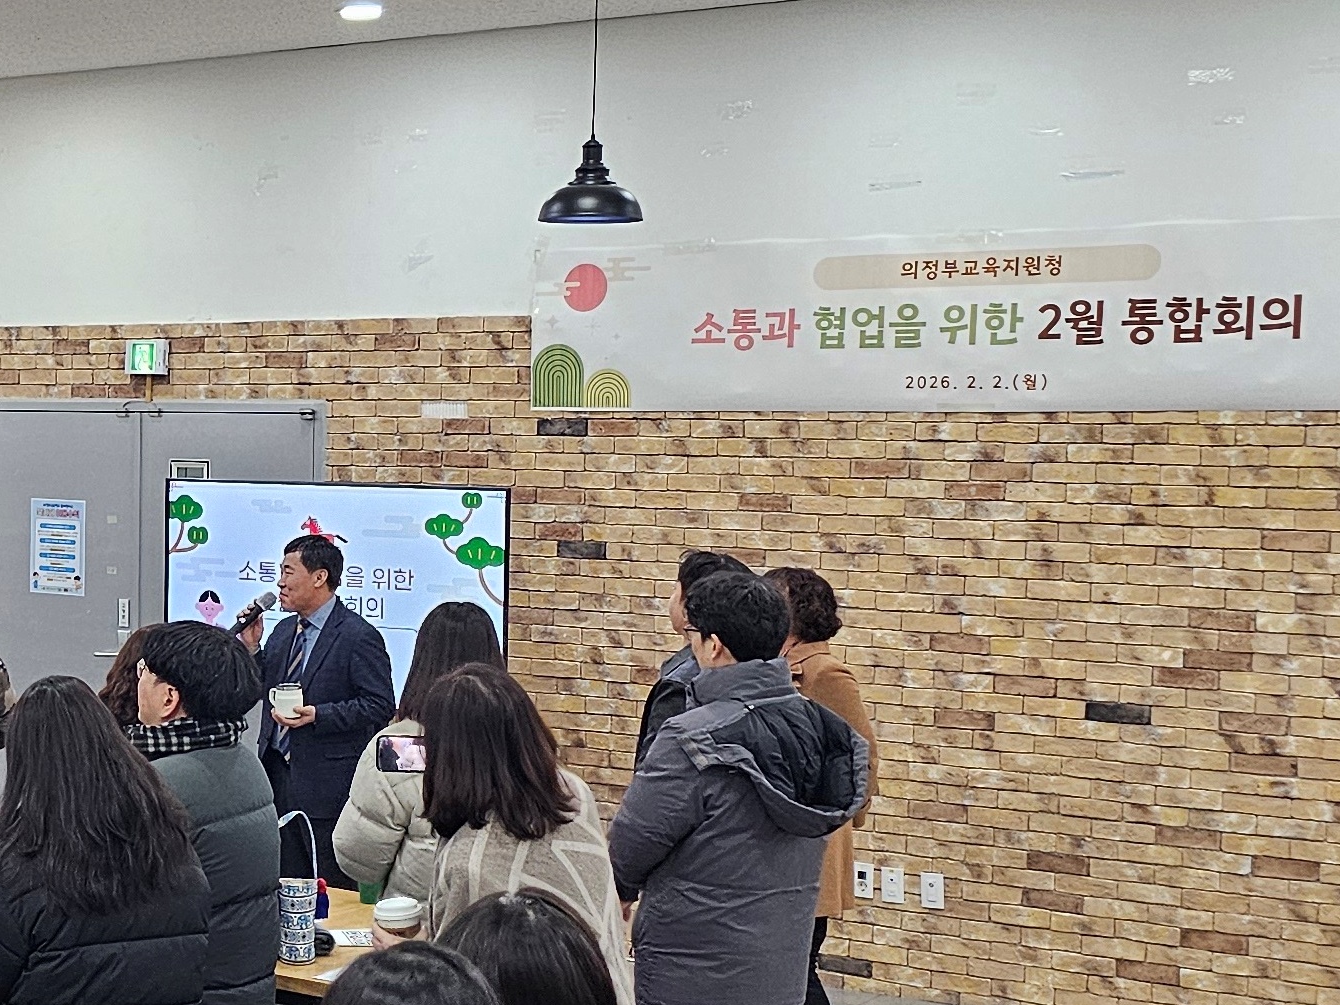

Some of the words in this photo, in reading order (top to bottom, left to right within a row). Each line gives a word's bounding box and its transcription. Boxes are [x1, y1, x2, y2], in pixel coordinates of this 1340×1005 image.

[900, 255, 1063, 281] 의정부교육지원청
[691, 308, 801, 351] 소통과
[813, 303, 927, 349] 협업을
[939, 302, 1024, 346] 위한
[1037, 300, 1104, 346] 2월
[1121, 294, 1303, 346] 통합회의
[905, 375, 958, 390] 2026.
[239, 561, 280, 583] 소통
[372, 568, 415, 592] 위한
